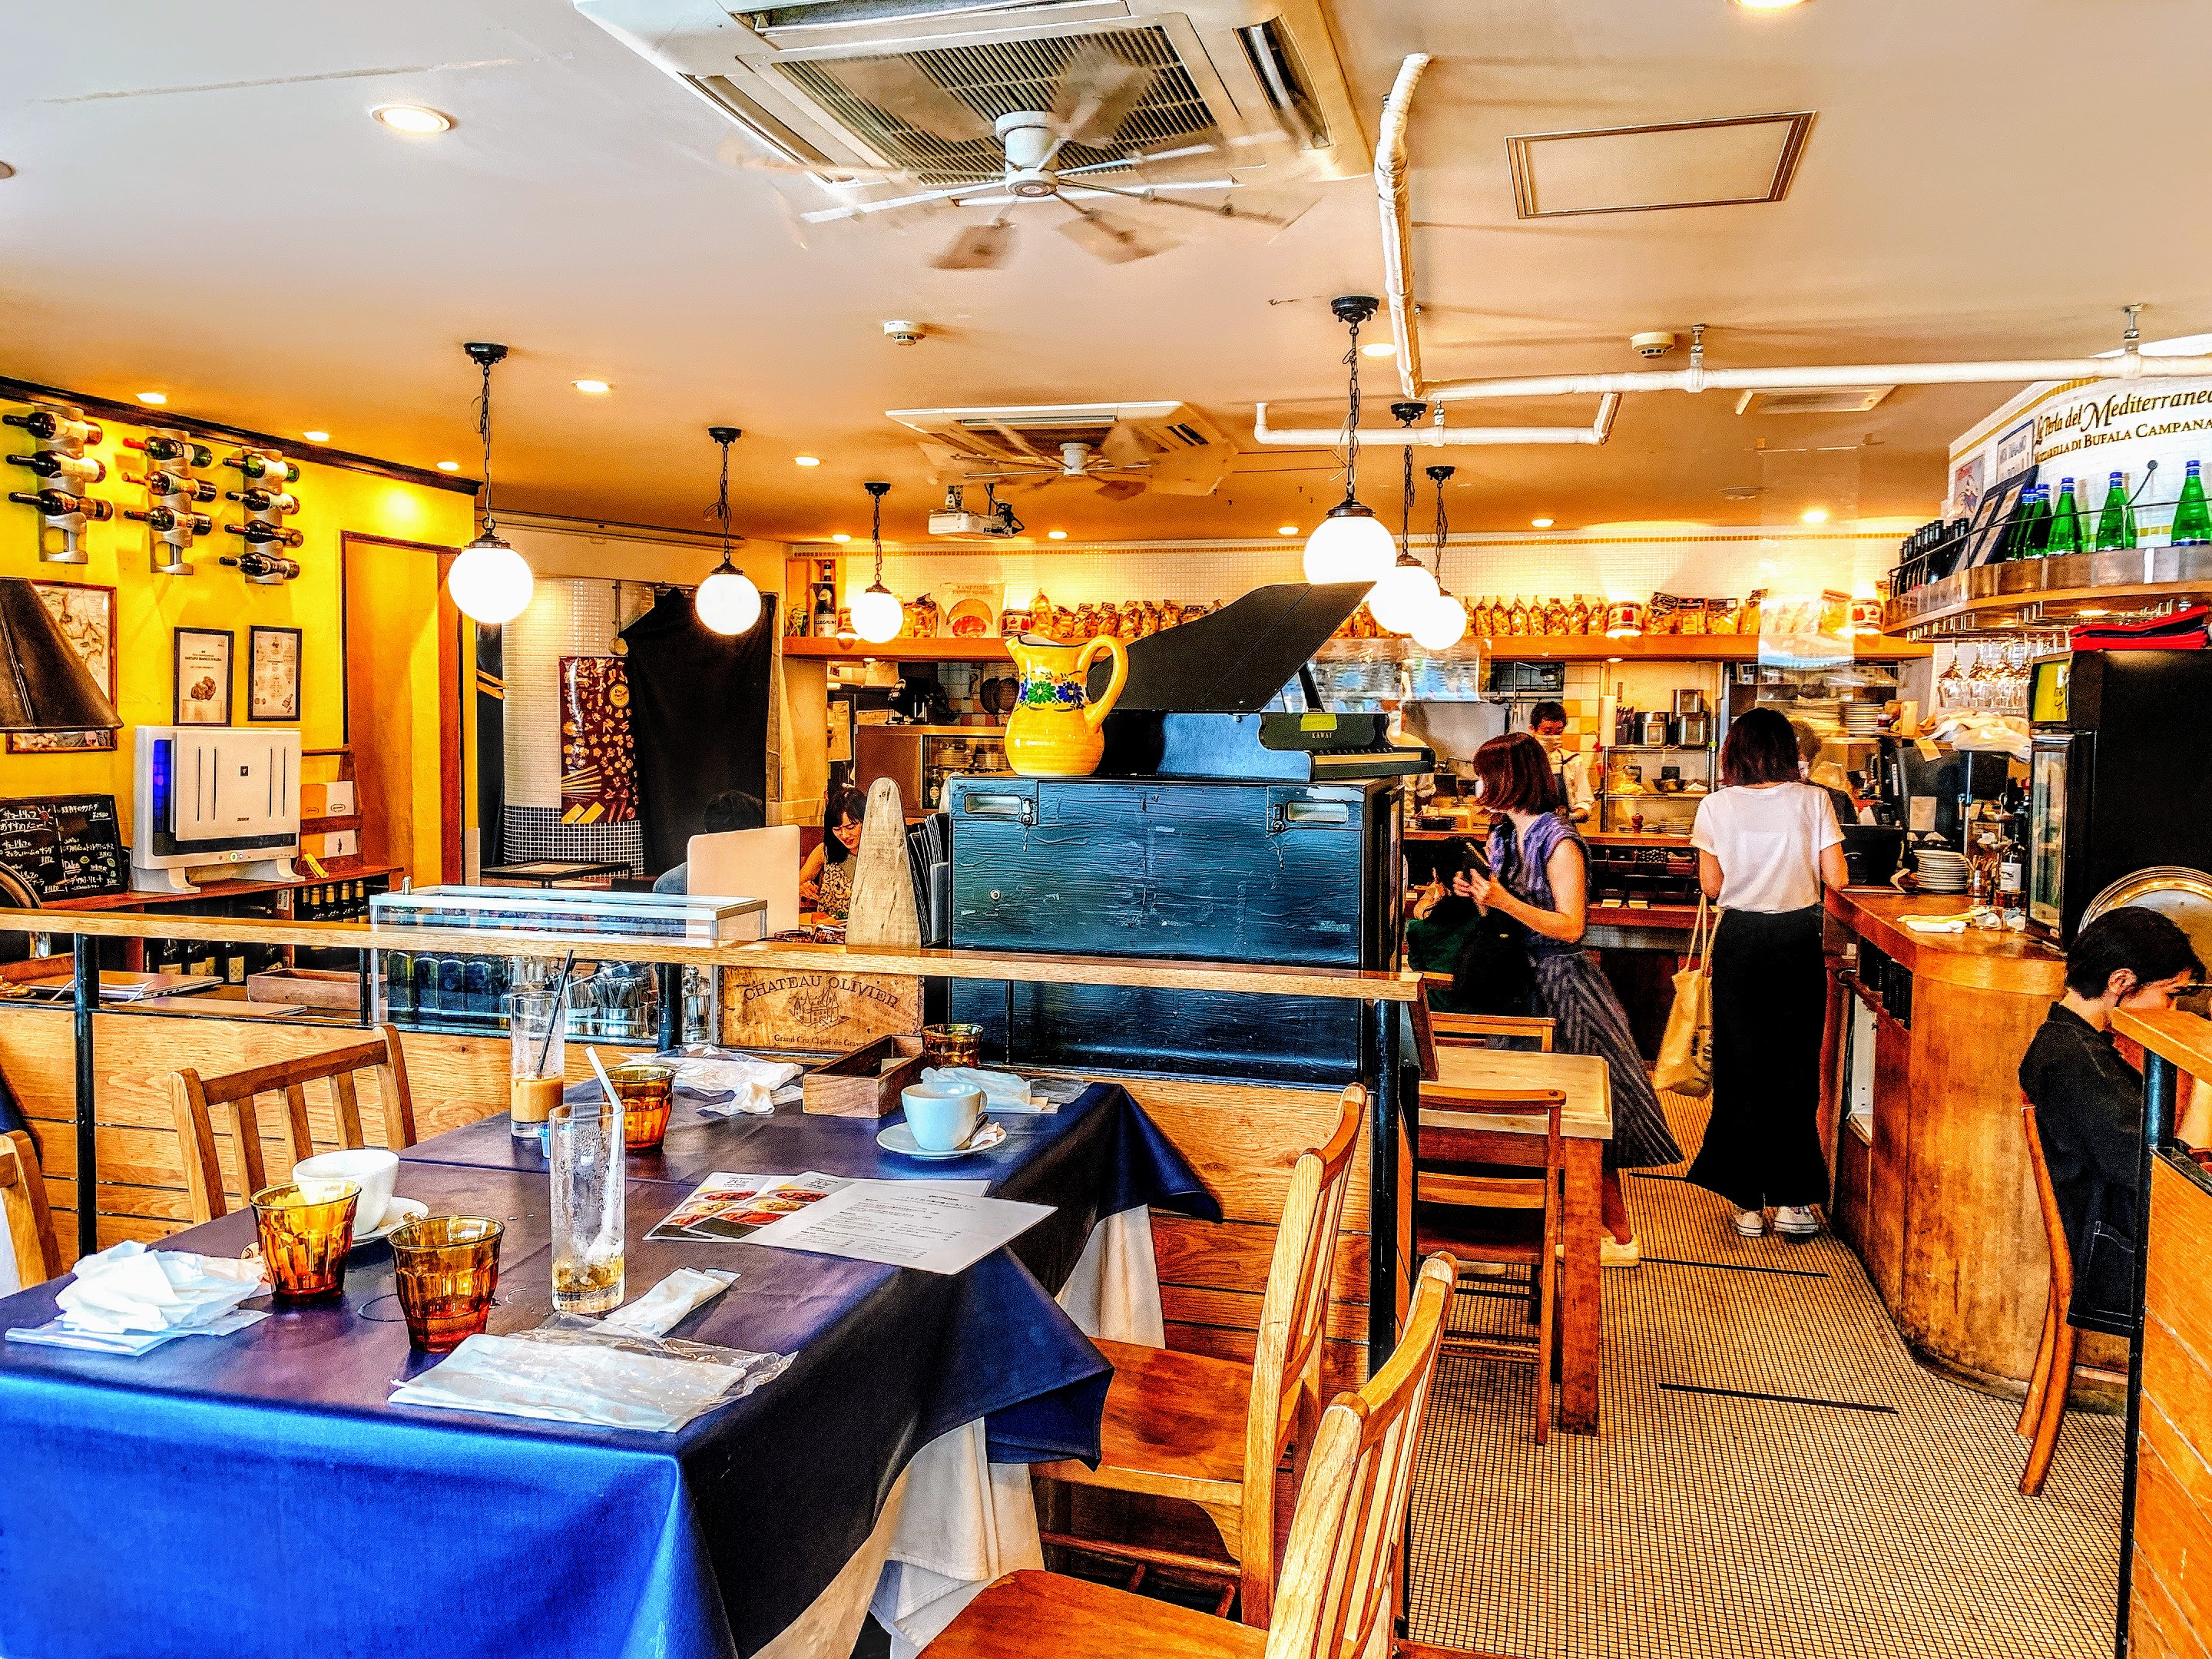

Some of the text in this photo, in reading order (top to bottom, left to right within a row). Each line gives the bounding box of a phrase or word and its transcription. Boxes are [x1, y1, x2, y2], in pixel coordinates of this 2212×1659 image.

[2065, 404, 2083, 428] del
[2071, 439, 2081, 451] DI
[2084, 430, 2132, 449] BUFALA
[743, 975, 899, 1008] CHATEAU OLIVIER
[774, 1034, 795, 1042] Grand
[796, 1035, 810, 1044] Cru
